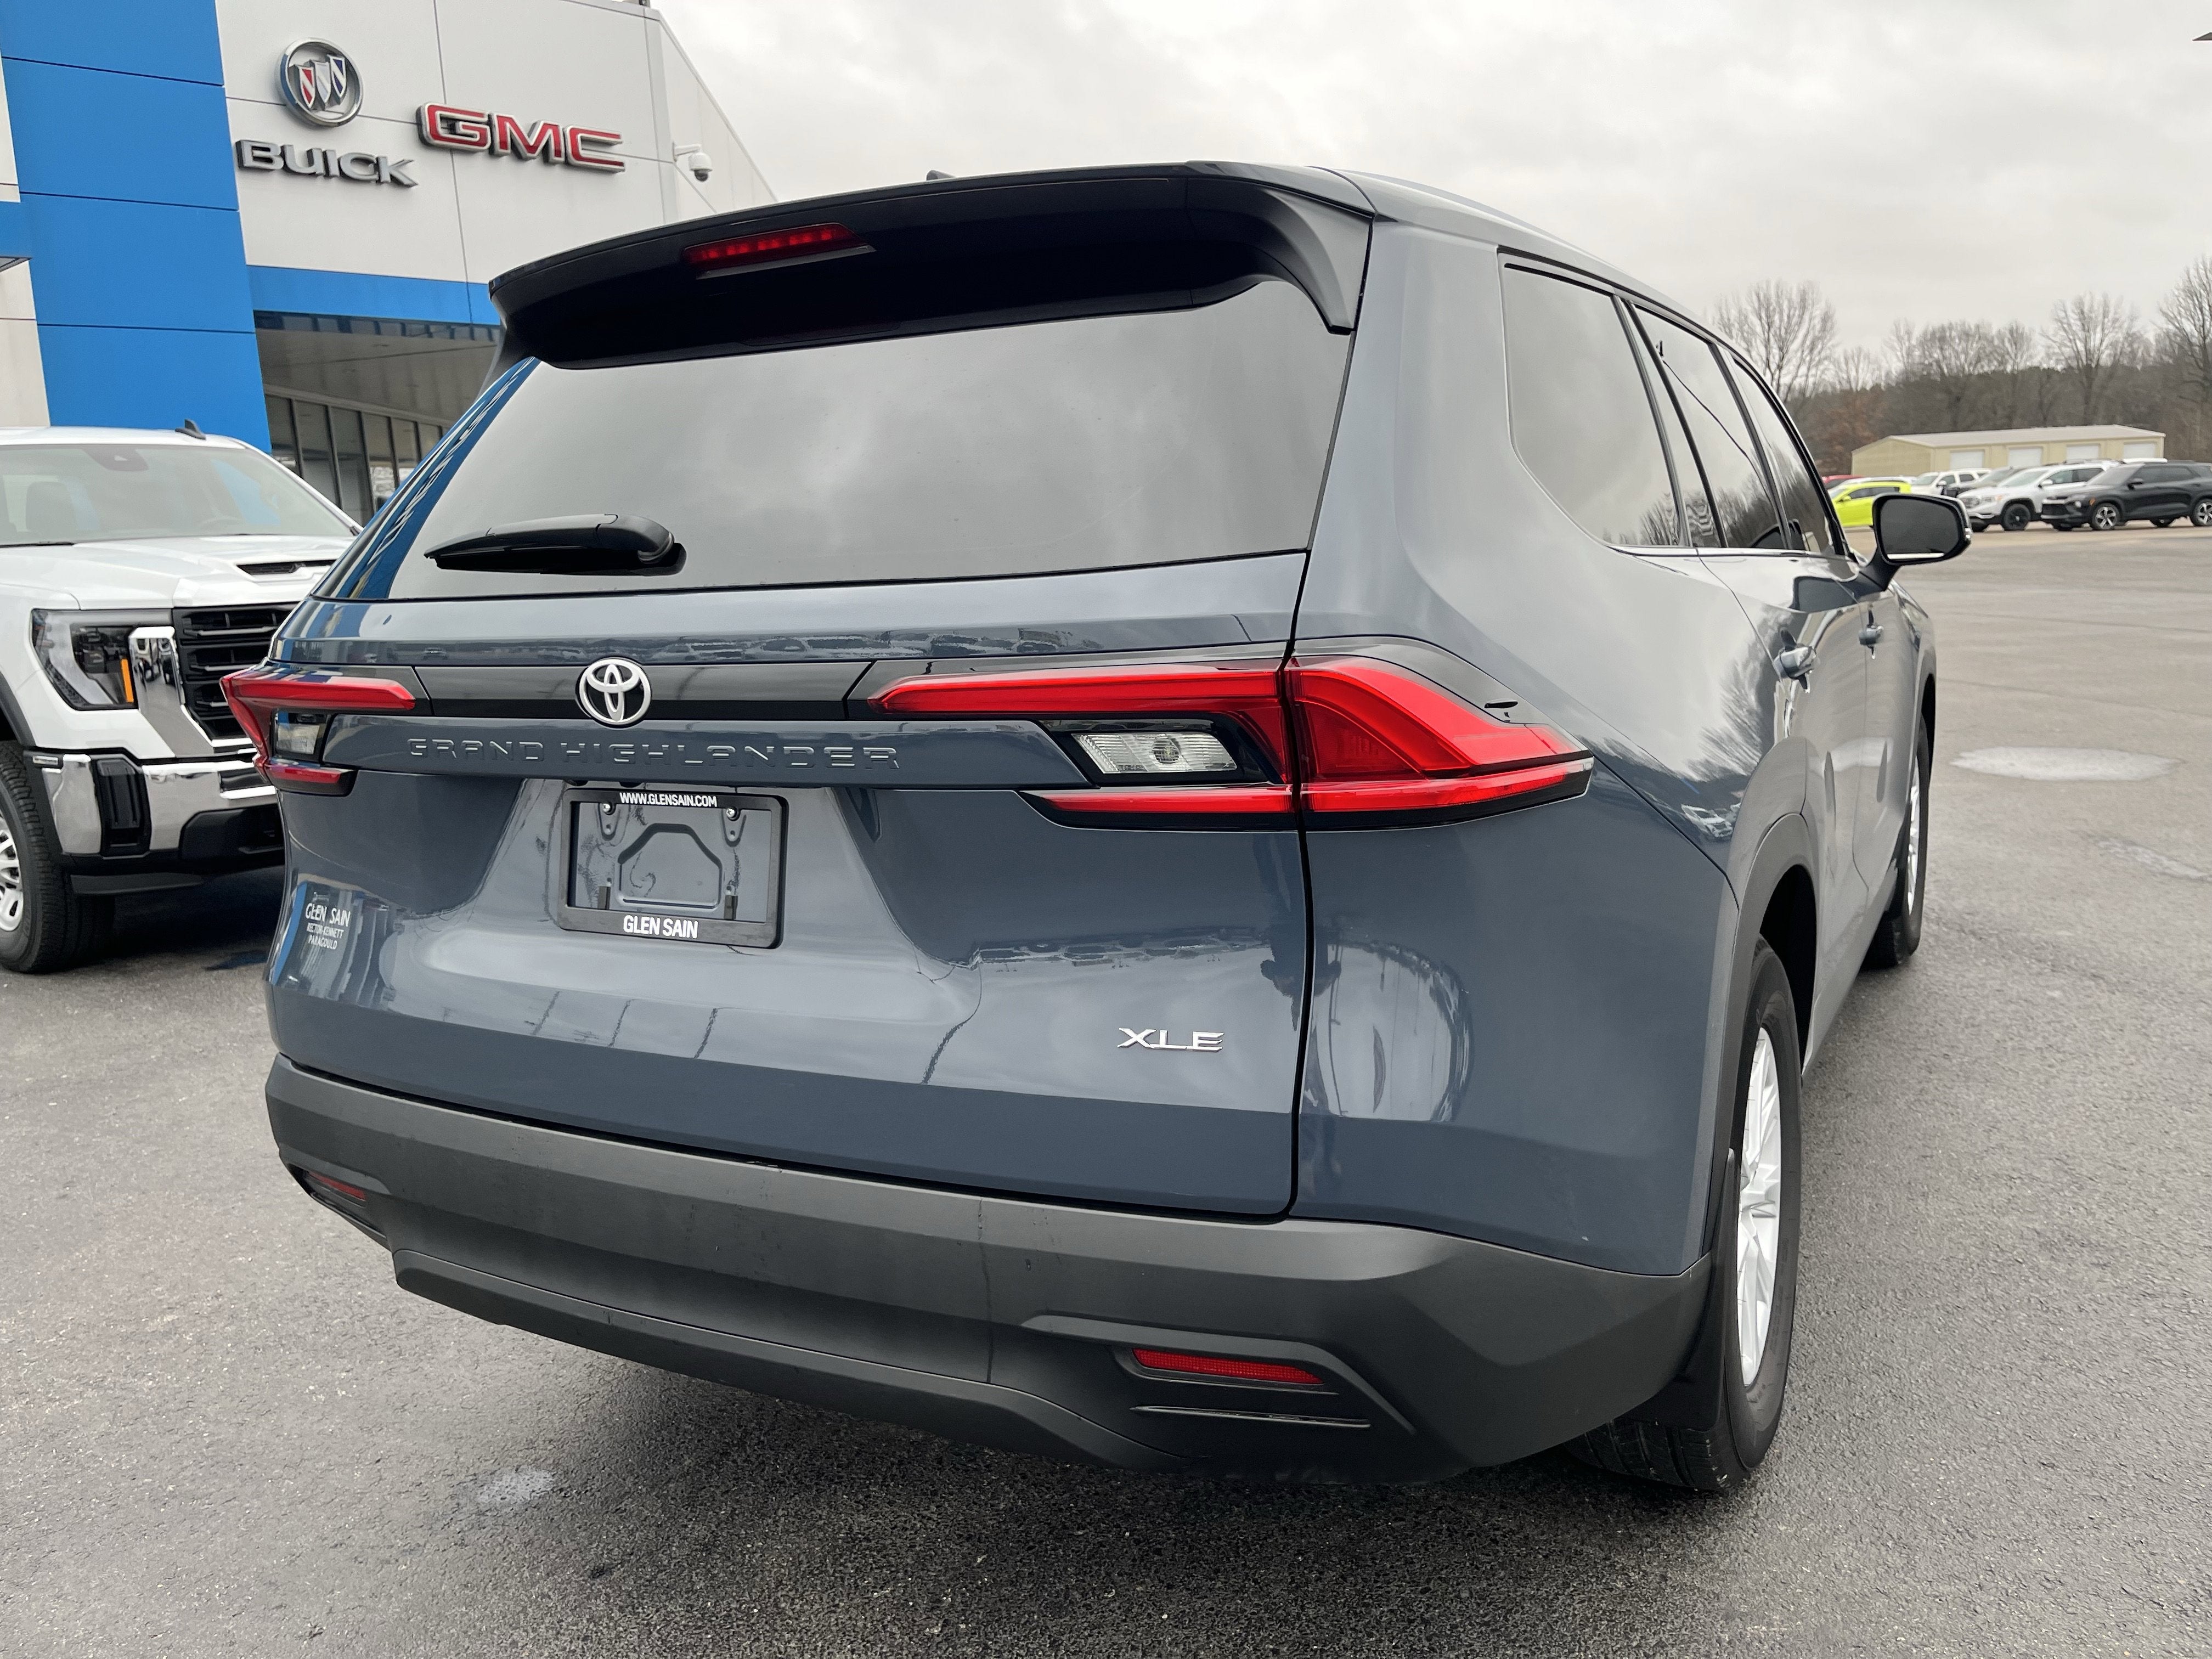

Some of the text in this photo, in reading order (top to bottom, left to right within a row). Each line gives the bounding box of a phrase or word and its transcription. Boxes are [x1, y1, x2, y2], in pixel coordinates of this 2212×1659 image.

[417, 101, 625, 172] GMC
[235, 139, 417, 187] BUICK
[408, 738, 899, 769] GRAND HIGHLANDER
[619, 792, 717, 808] WWW.GLENSAIN.COM
[306, 902, 351, 927] GLEN SAIN
[623, 915, 698, 939] GLEN SAIN
[1117, 1027, 1224, 1052] XLE
